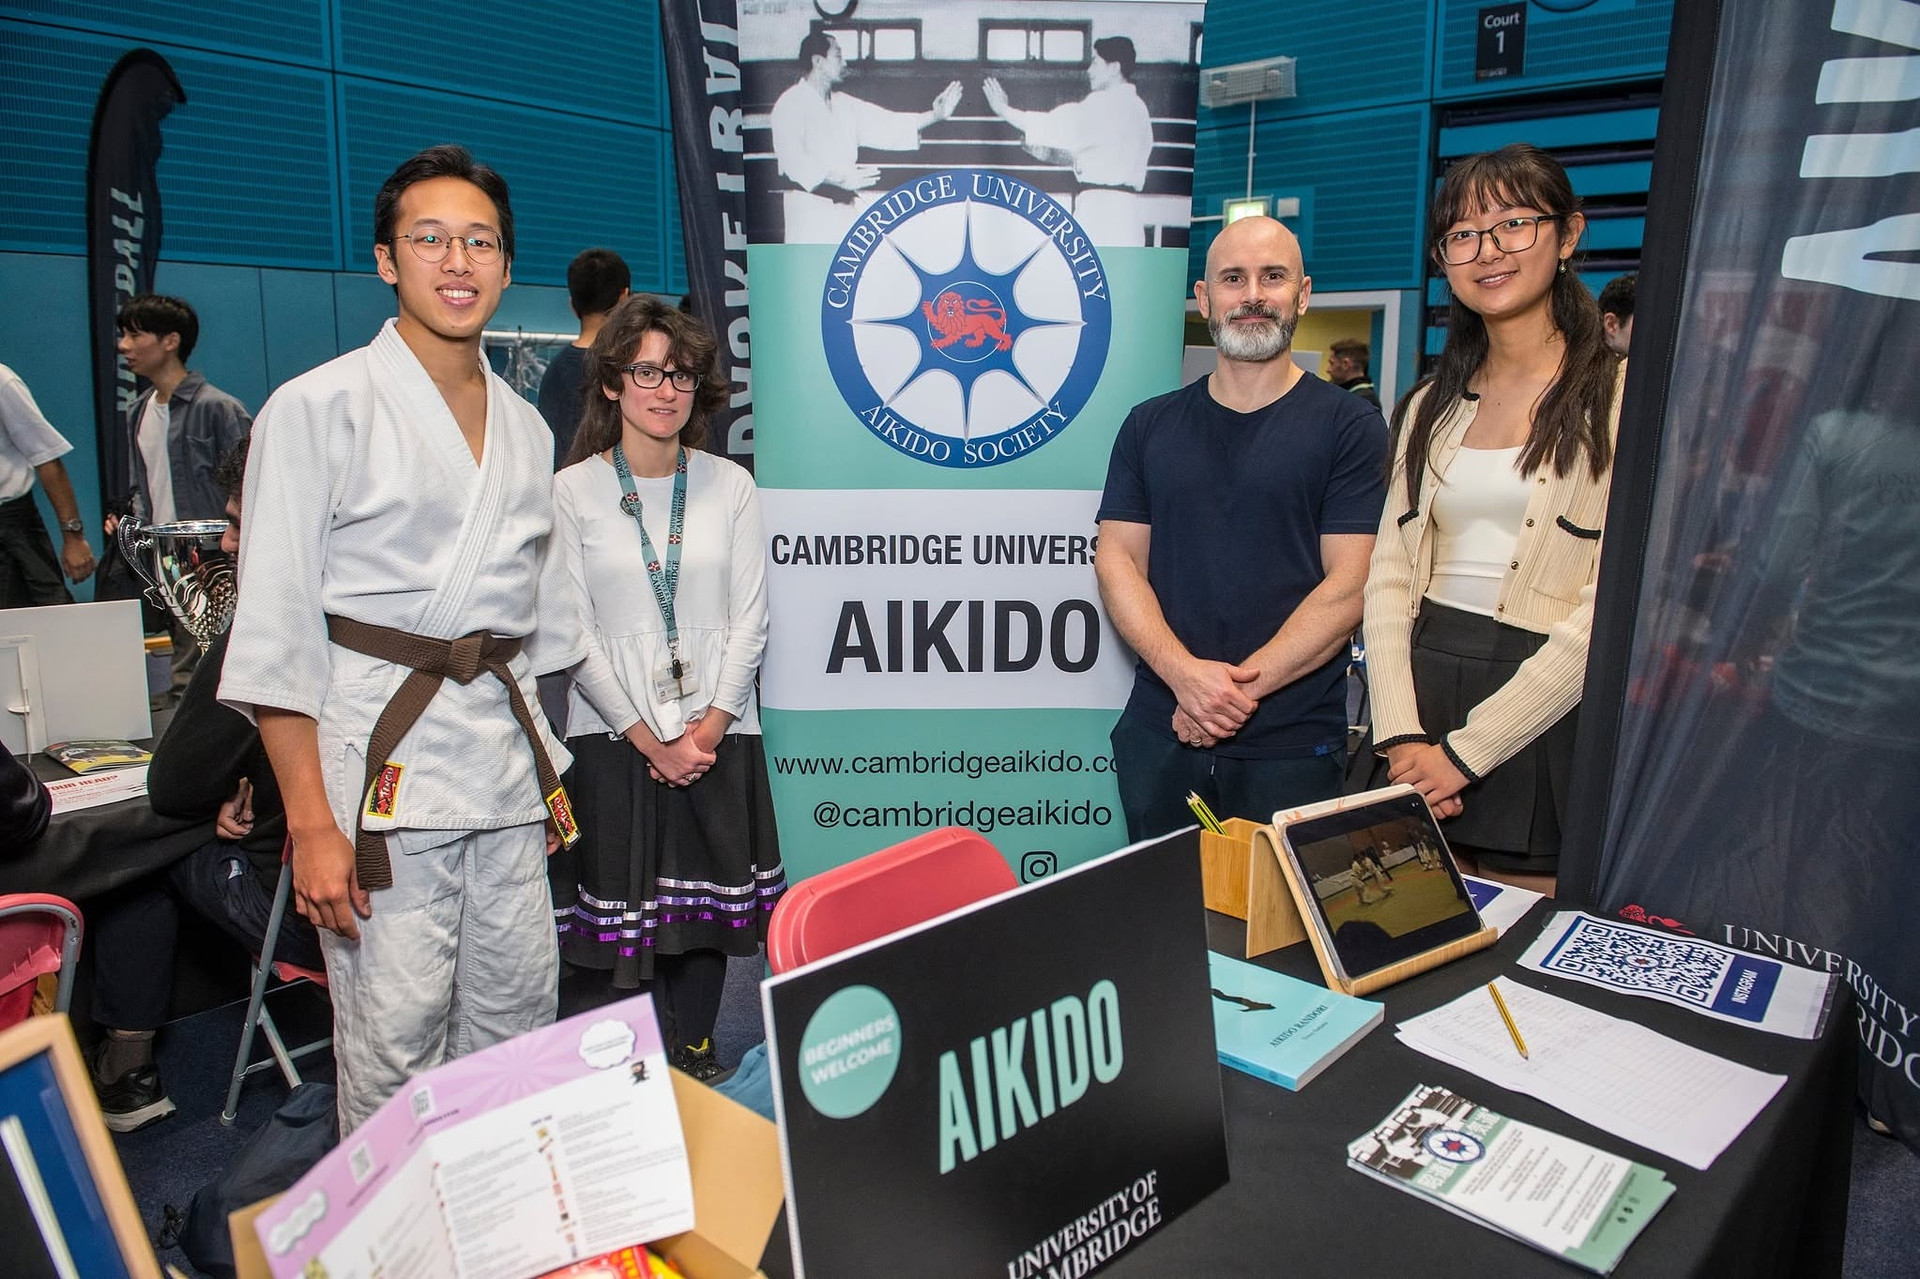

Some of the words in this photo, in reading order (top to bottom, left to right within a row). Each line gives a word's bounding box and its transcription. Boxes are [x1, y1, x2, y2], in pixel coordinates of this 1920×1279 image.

[1484, 12, 1521, 29] Court
[1496, 31, 1505, 54] 1
[827, 174, 957, 309] CAMBRIDGE
[971, 173, 1107, 301] UNIVERSITY
[860, 402, 951, 462] AIKIDO
[963, 400, 1070, 464] SOCIETY
[676, 488, 686, 535] CAMBRIDGE
[771, 534, 962, 566] CAMBRIDGE
[650, 573, 672, 623] CAMBRIDGE
[825, 599, 1101, 674] AIKIDO
[813, 799, 1113, 833] @cambridgeaikido
[1723, 924, 1919, 1037] UNIVERSITY
[1731, 969, 1758, 1004] INSTAGRAM
[804, 1013, 895, 1067] BEGINNERS
[811, 1037, 893, 1086] WELCOME
[1270, 1026, 1298, 1048] AIKIDO
[939, 979, 1123, 1175] AIKIDO
[1007, 1187, 1130, 1279] UNIVERSITY
[1132, 1169, 1157, 1203] OF
